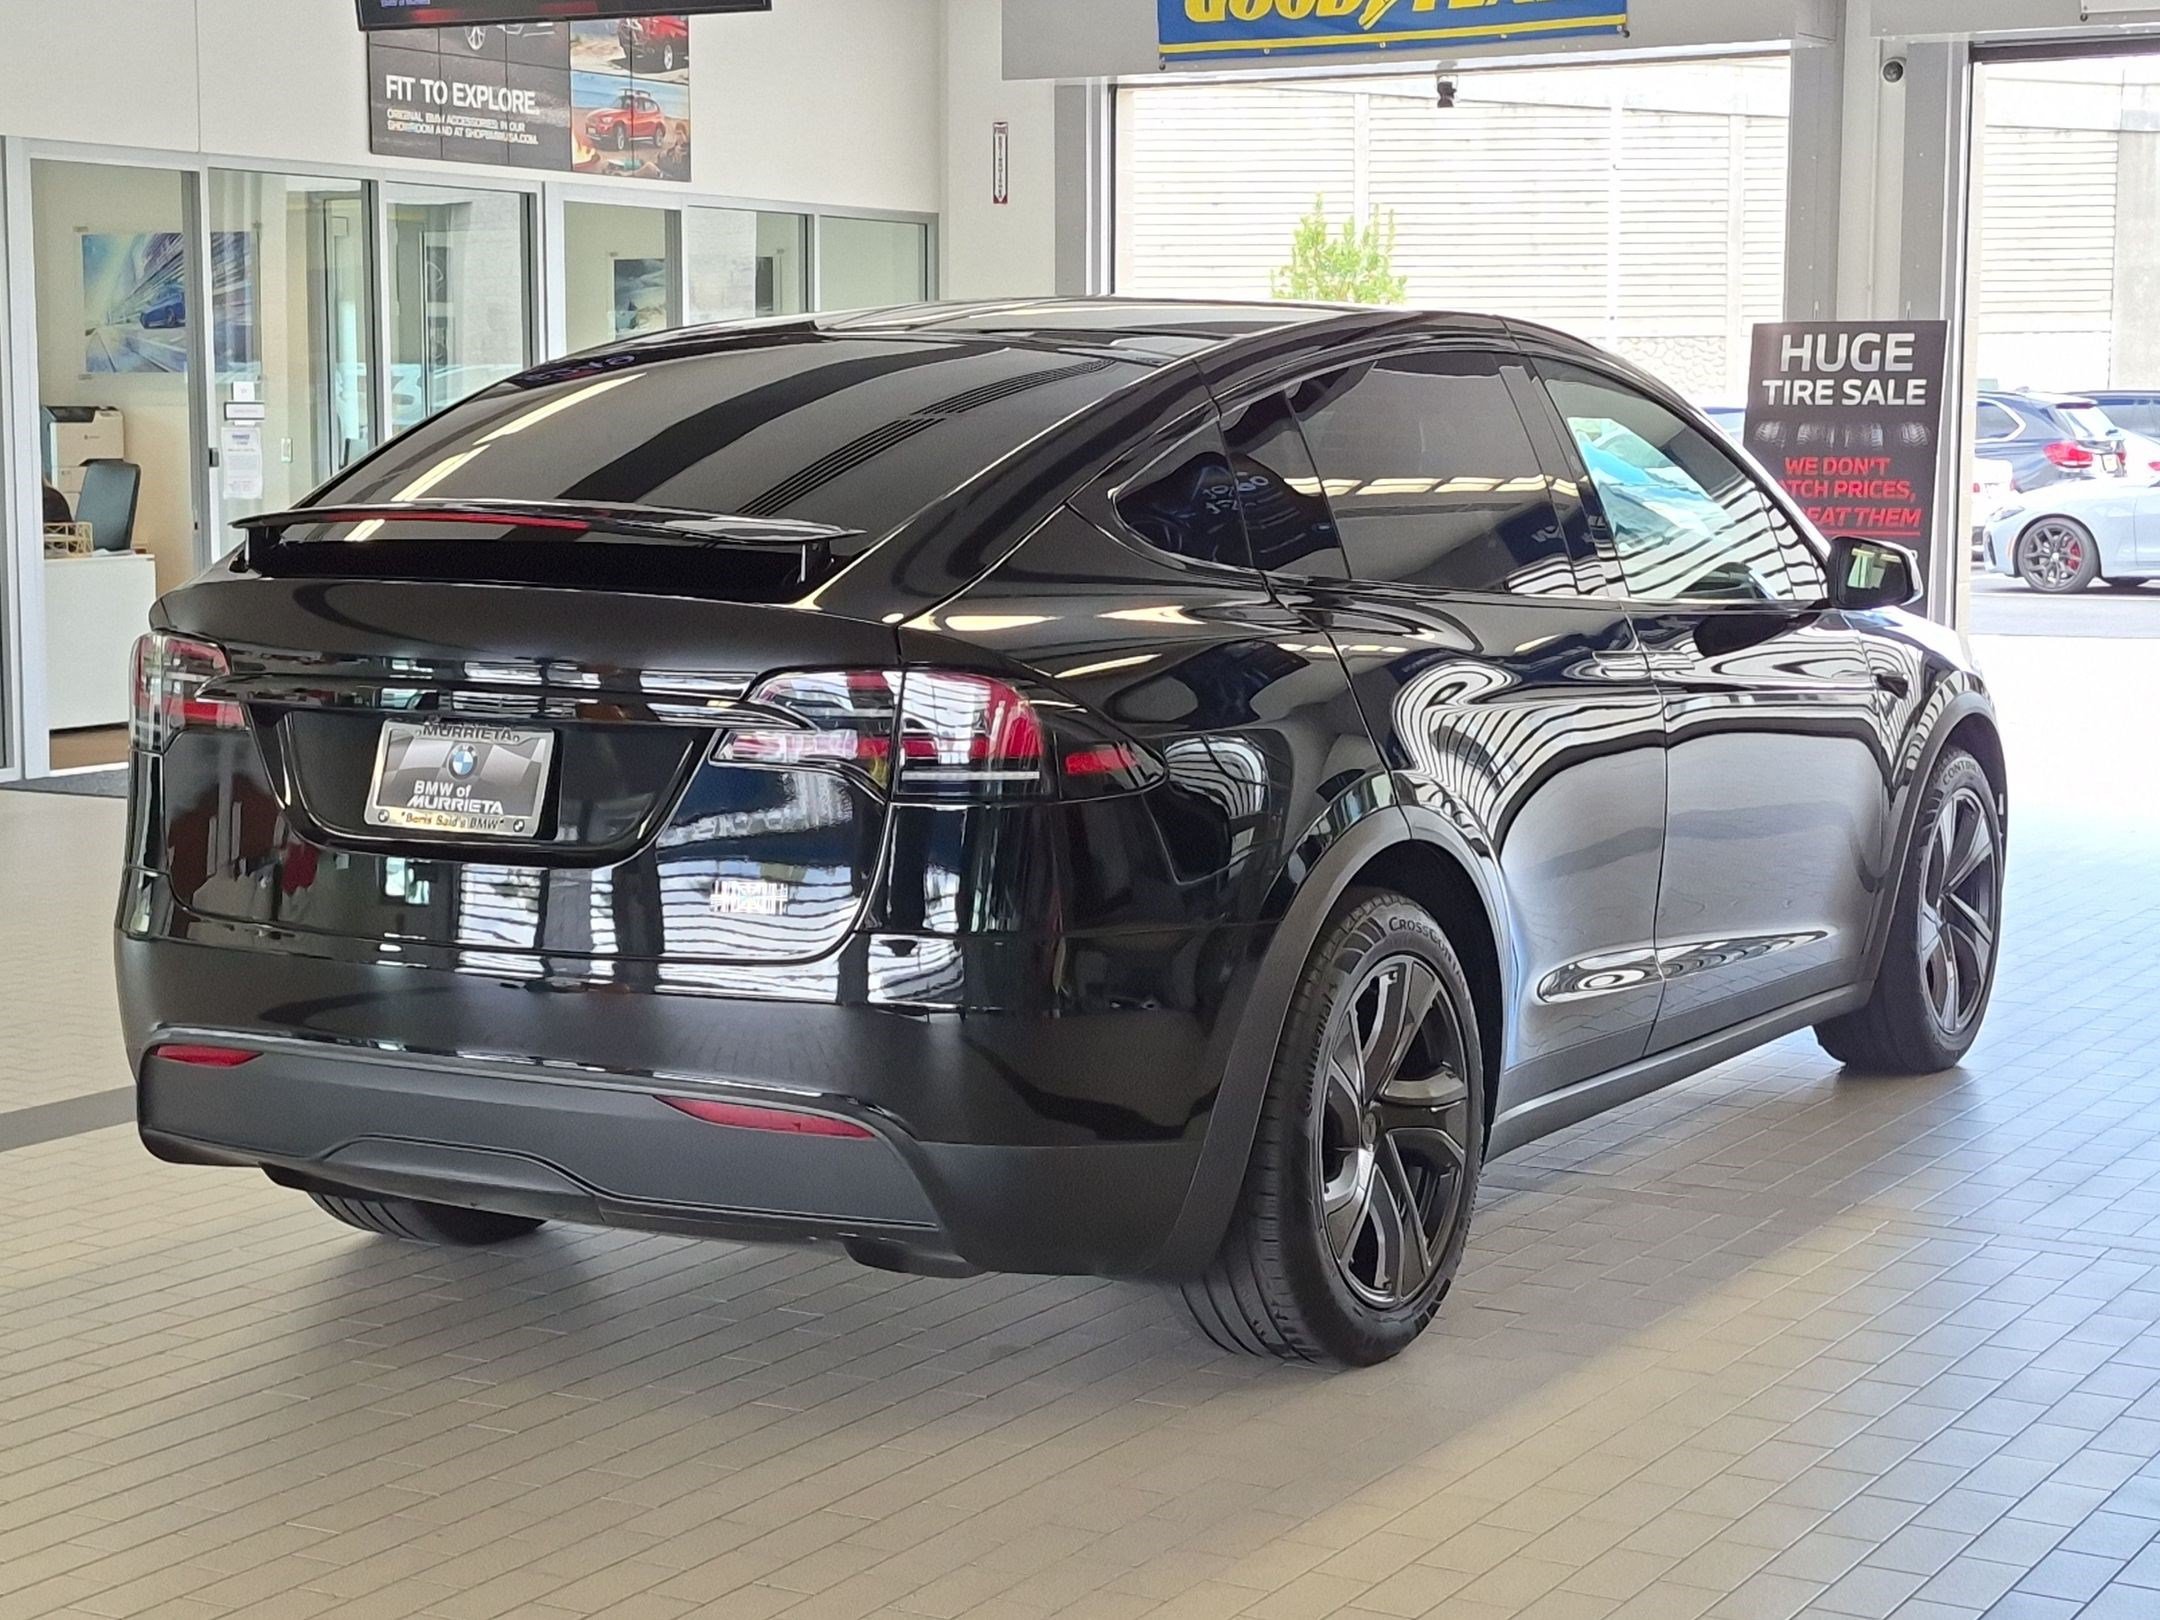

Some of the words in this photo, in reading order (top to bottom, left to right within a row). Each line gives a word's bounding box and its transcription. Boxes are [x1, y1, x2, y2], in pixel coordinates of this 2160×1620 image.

[385, 75, 415, 101] FIT
[420, 78, 448, 104] TO
[452, 82, 540, 115] EXPLORE.
[435, 124, 453, 136] AND
[454, 127, 464, 137] AT
[509, 121, 525, 132] OUR
[1780, 333, 1916, 372] HUGE
[1762, 379, 1835, 406] TIRE
[1842, 379, 1927, 406] SALE
[1785, 457, 1819, 476] WE
[1823, 457, 1891, 476] DON'T
[1781, 480, 1828, 499] TCH
[1834, 480, 1916, 502] PRICES,
[1803, 507, 1851, 527] EAT
[1854, 507, 1922, 528] THEM
[423, 725, 512, 740] MURRIETA
[414, 780, 454, 796] BMW
[456, 785, 472, 798] of
[407, 795, 504, 815] MURRIETA
